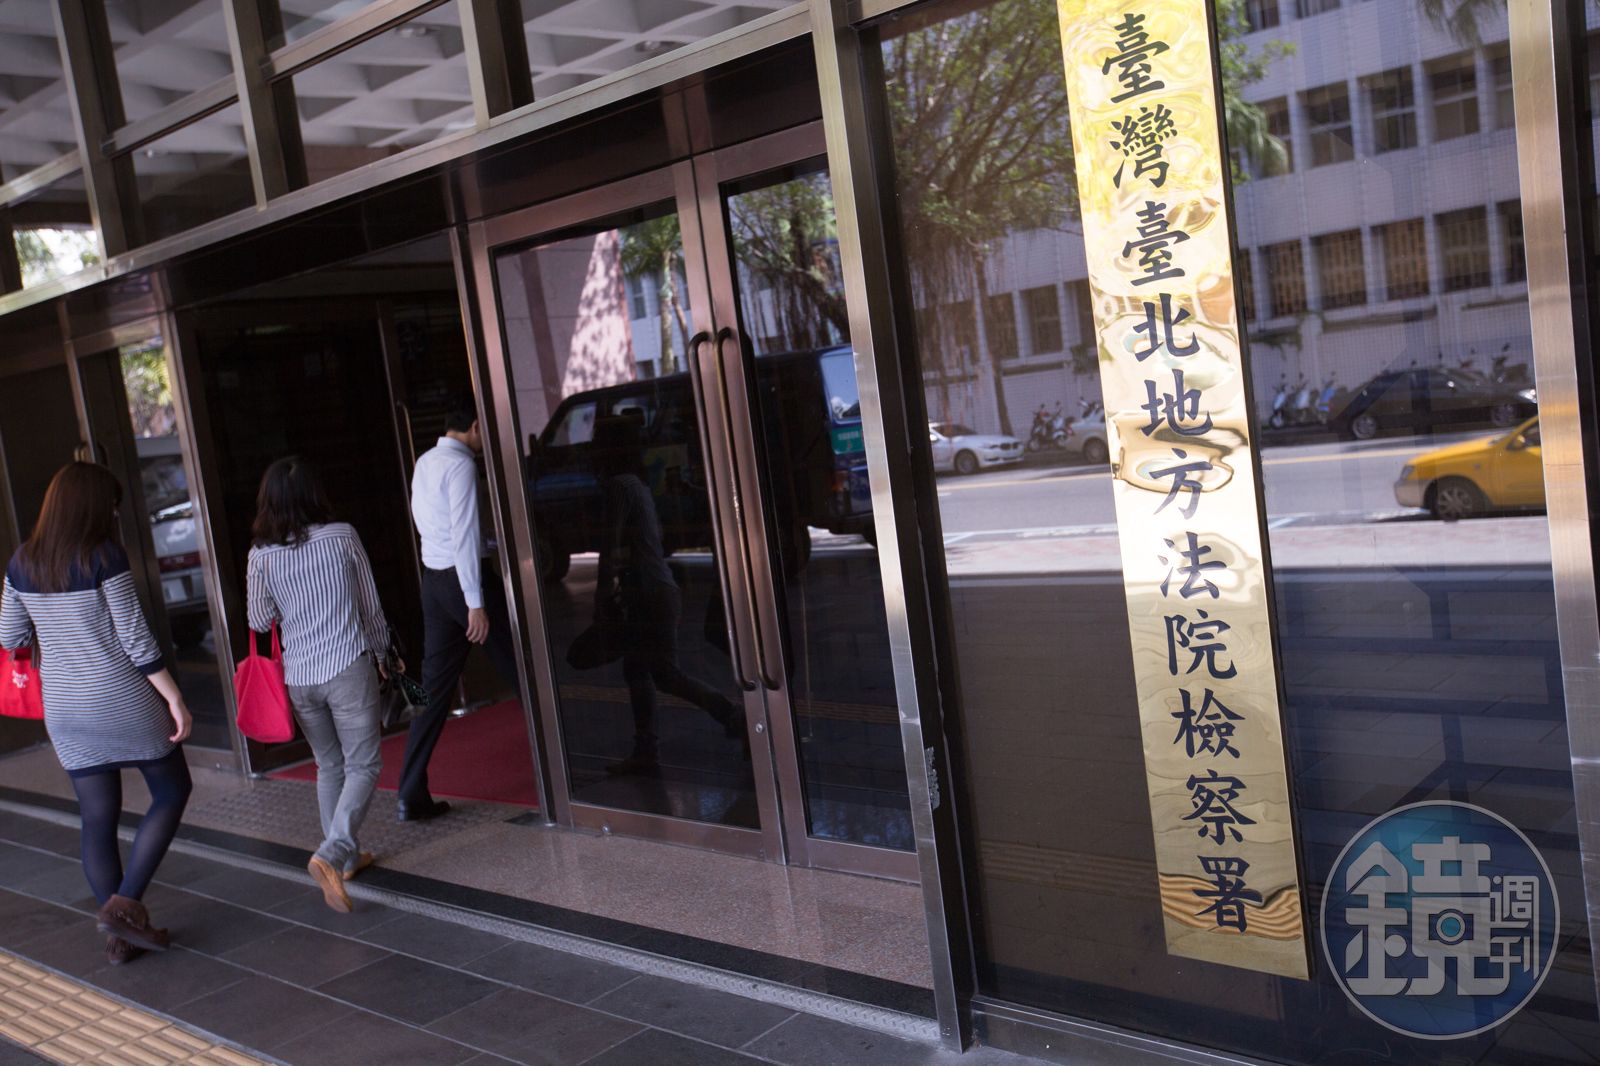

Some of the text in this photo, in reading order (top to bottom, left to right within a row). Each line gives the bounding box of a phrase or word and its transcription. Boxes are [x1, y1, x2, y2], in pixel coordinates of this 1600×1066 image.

[1102, 13, 1263, 932] 臺灣臺北地方法院檢察署
